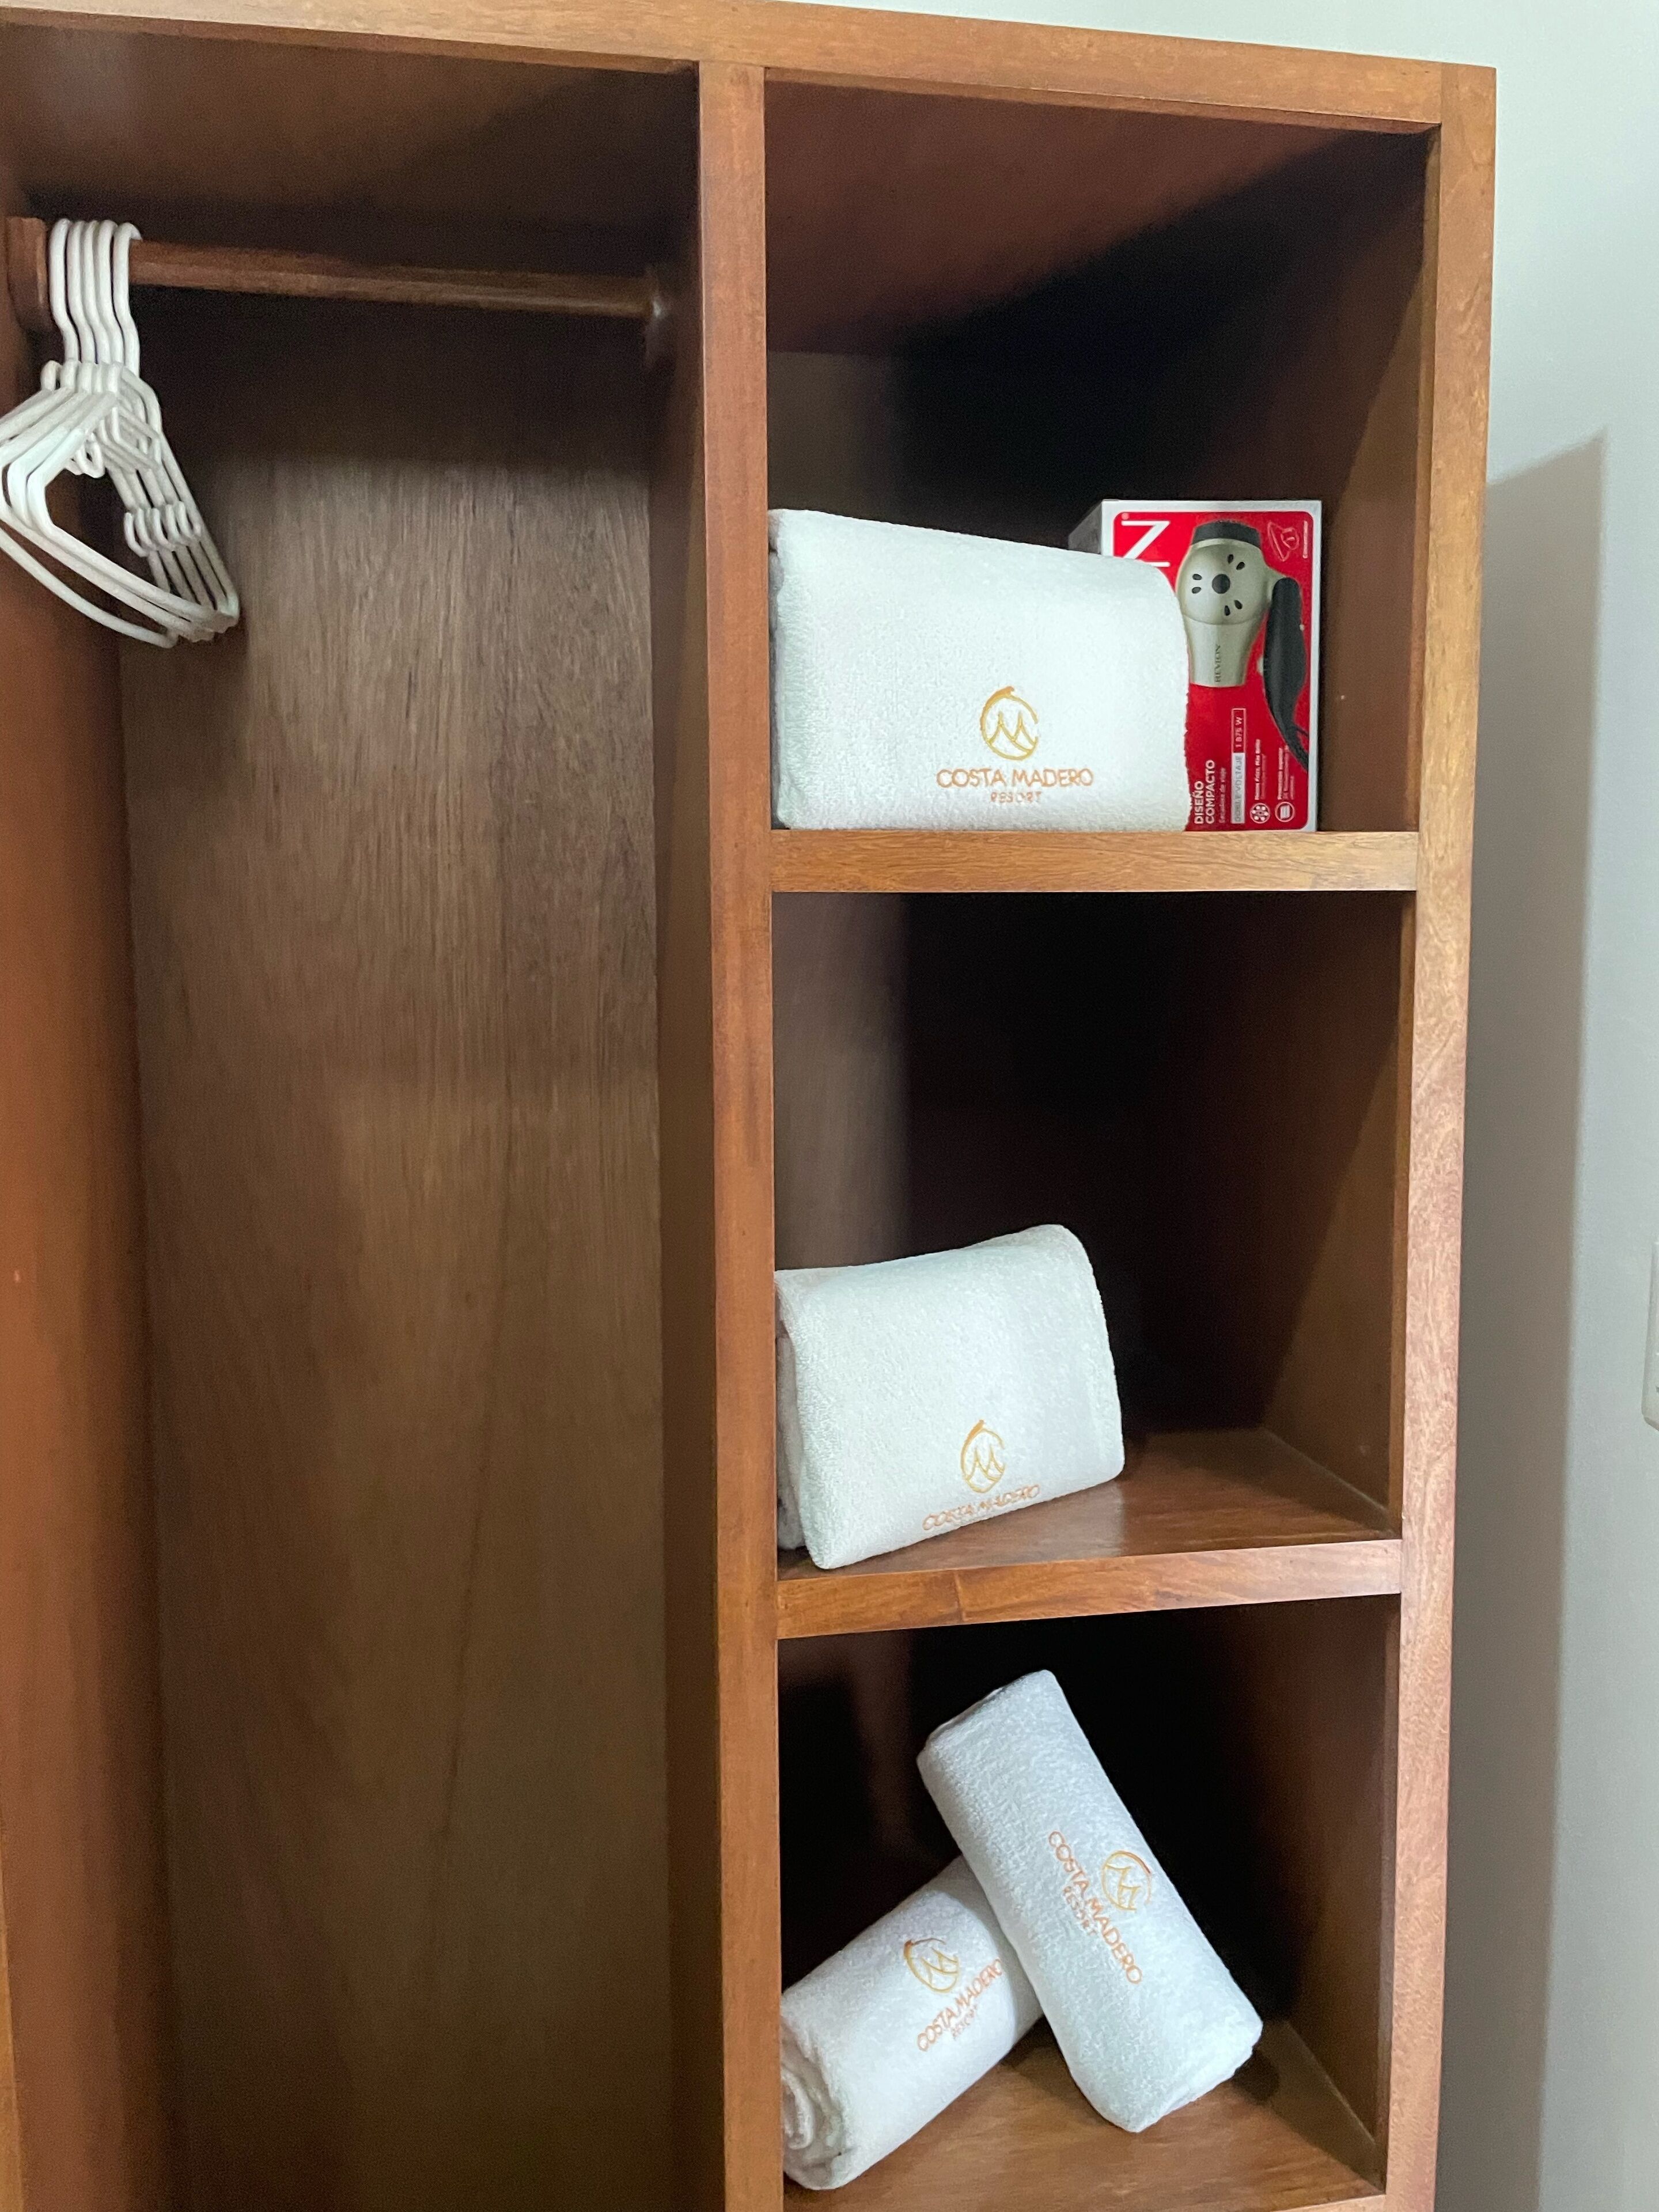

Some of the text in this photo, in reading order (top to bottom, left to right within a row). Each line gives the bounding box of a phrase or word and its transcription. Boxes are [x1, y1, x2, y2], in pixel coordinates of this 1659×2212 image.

[936, 767, 1094, 788] COSTA MADERO
[1205, 759, 1215, 824] COMPACTO
[1192, 781, 1204, 824] DISEÑO
[1048, 1831, 1143, 1984] COSTA MADERO
[917, 2007, 956, 2052] COSTA
